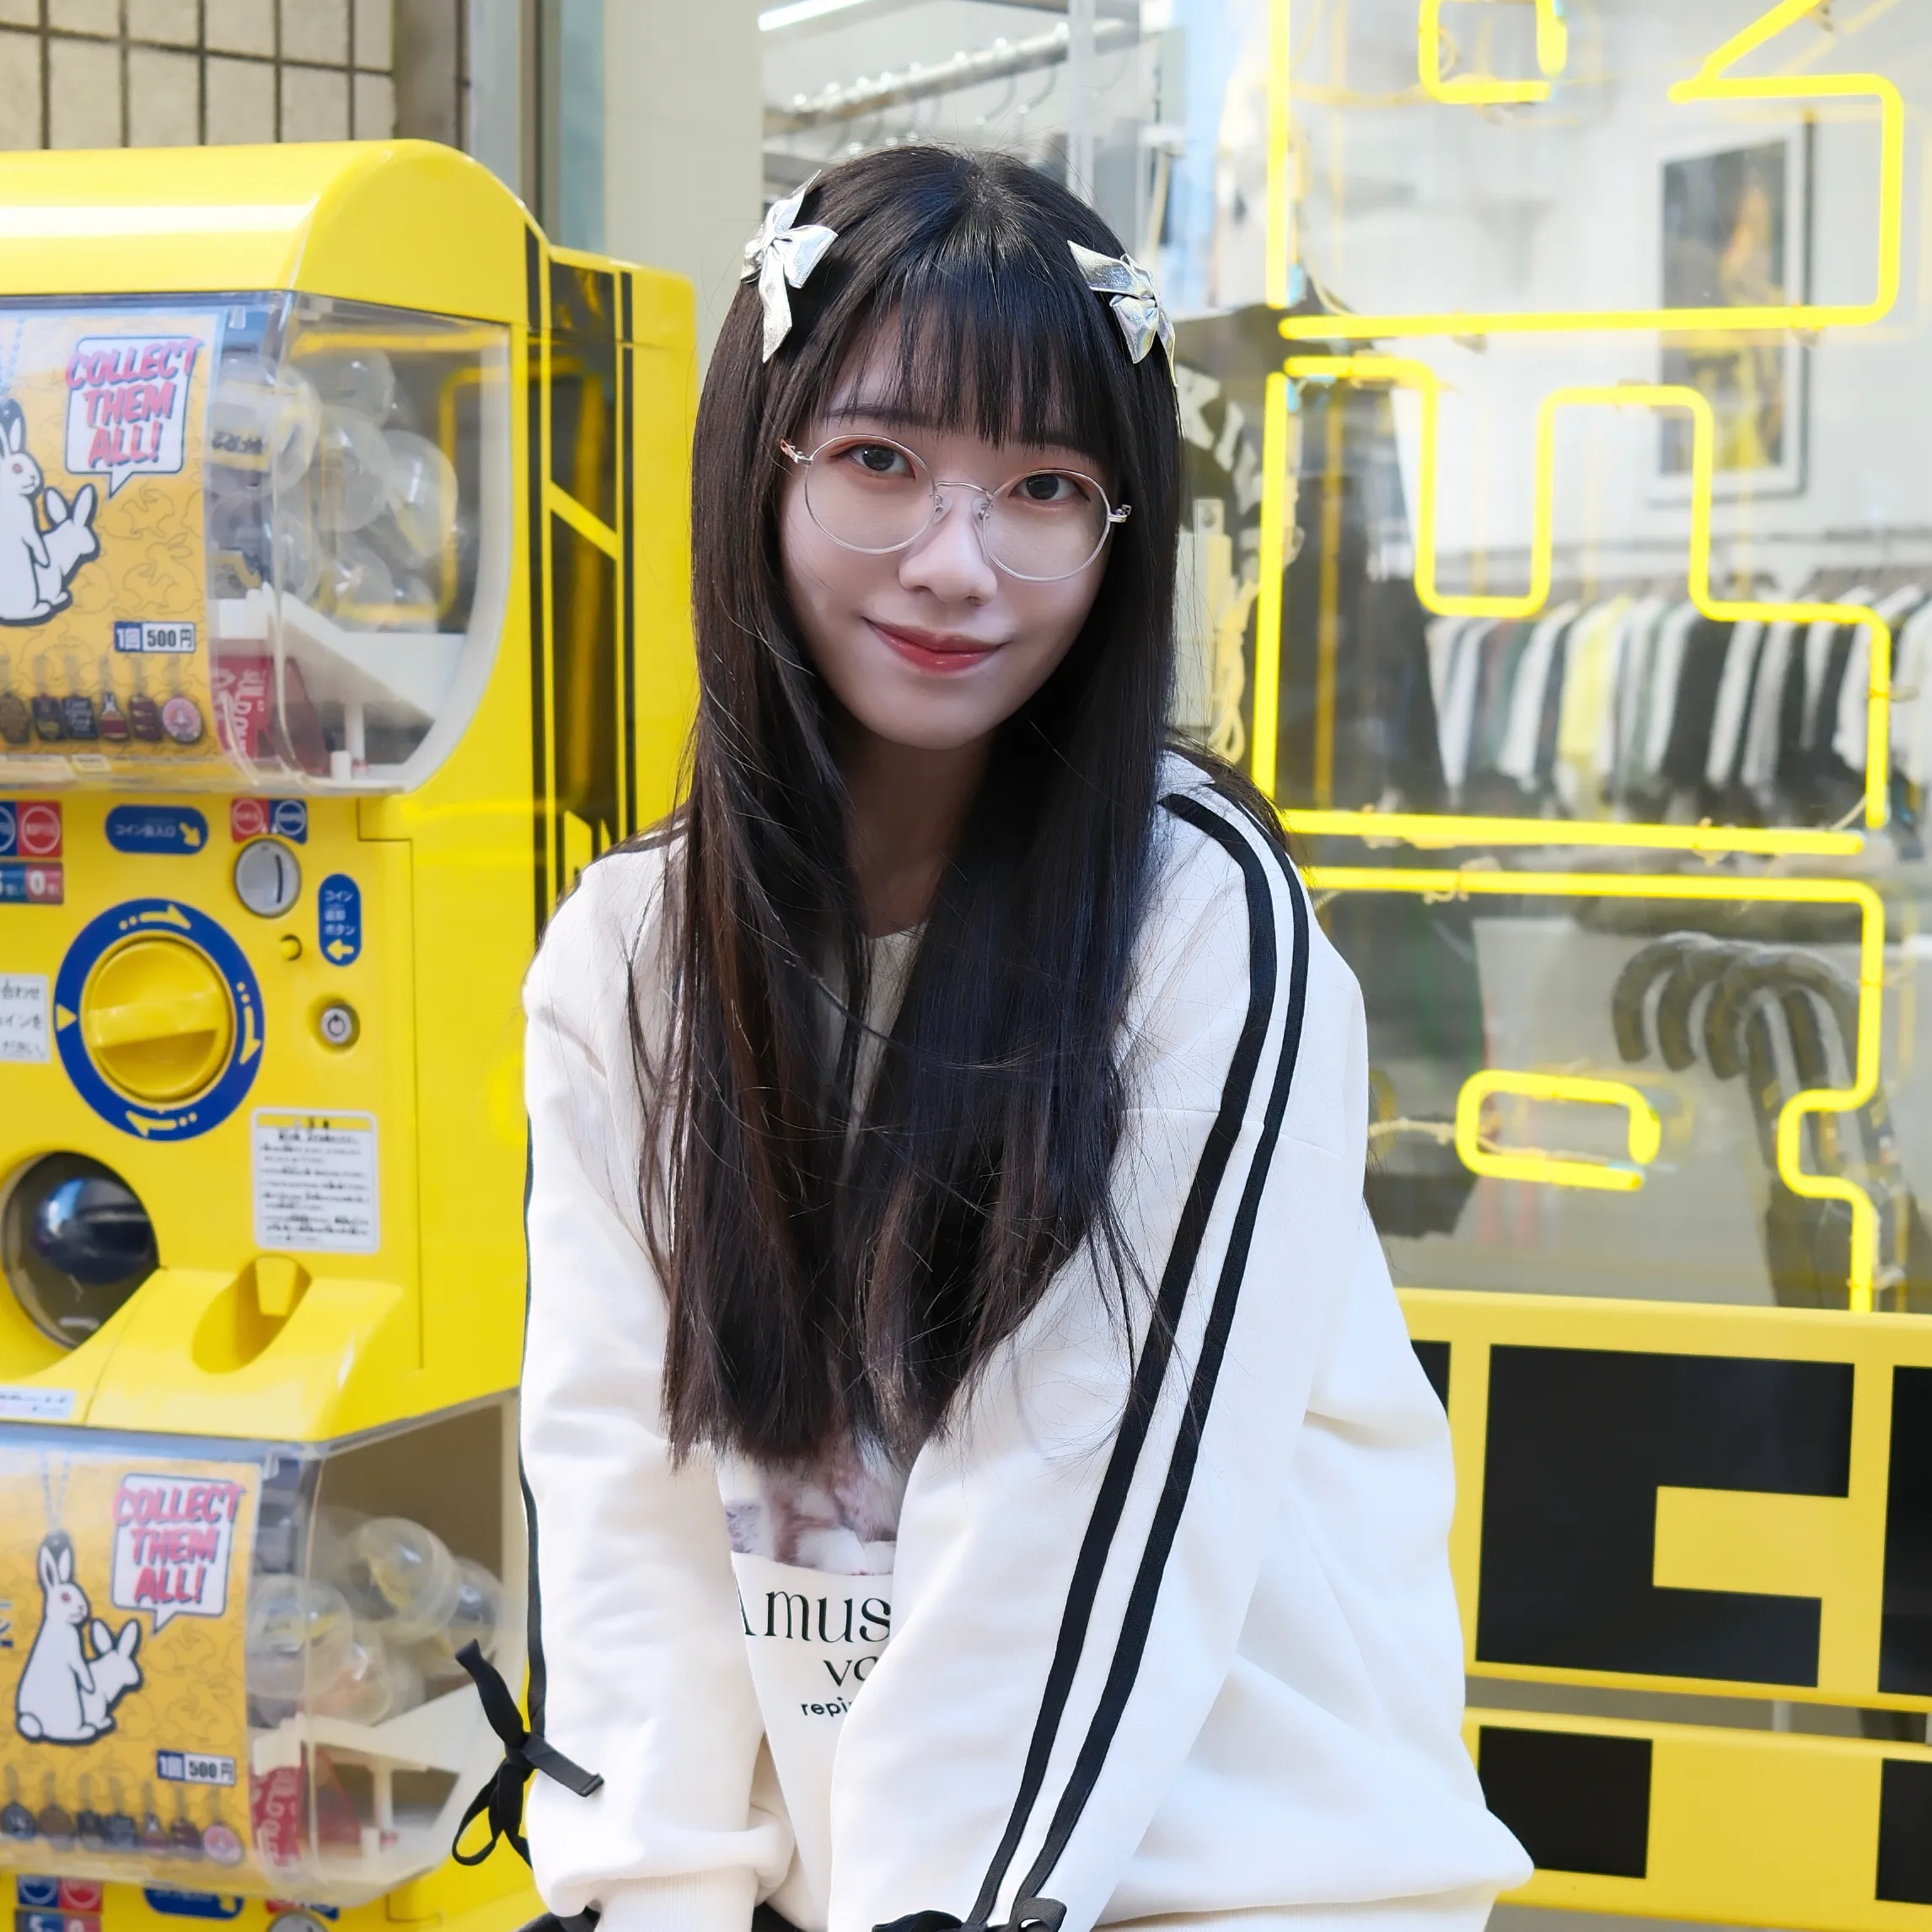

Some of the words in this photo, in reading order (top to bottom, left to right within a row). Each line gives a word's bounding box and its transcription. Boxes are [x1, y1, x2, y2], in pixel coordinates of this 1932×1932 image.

[66, 337, 205, 389] COLLECT
[83, 381, 176, 427] THEM
[88, 420, 163, 469] ALL!
[148, 629, 192, 648] 500円
[113, 1483, 247, 1526] COLLECT
[131, 1525, 220, 1565] THEM
[134, 1564, 207, 1605] ALL!
[801, 1696, 853, 1717] repi
